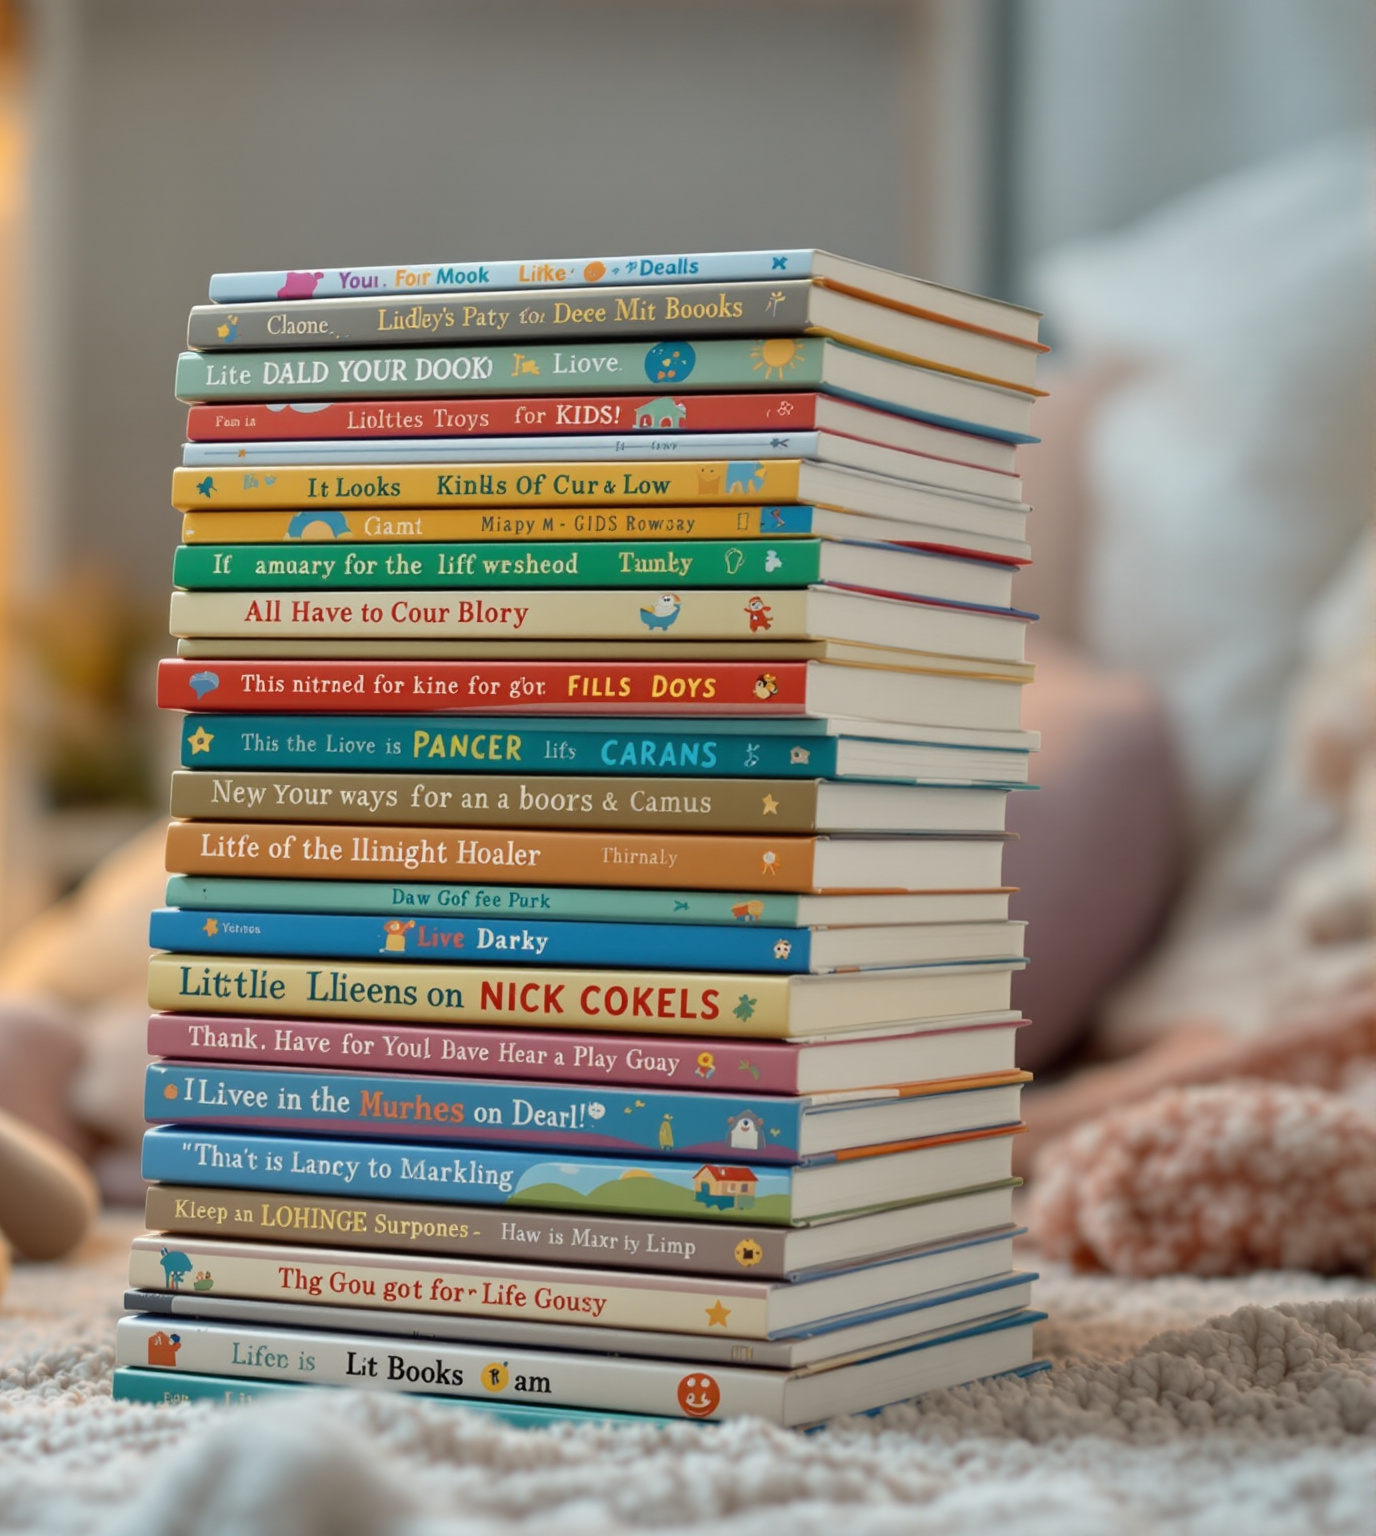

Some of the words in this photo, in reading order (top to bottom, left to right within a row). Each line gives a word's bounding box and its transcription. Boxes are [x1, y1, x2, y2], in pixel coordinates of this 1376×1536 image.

[436, 266, 490, 285] Mook
[639, 257, 699, 277] Dealls
[461, 306, 510, 330] Paty
[614, 297, 656, 322] Mit
[665, 293, 744, 320] Boooks
[206, 364, 252, 386] Lite
[262, 361, 330, 385] DALD
[338, 358, 408, 383] YOUR
[514, 406, 547, 424] for
[555, 404, 621, 425] KIDS!
[307, 477, 330, 498] It
[335, 475, 402, 498] Looks
[516, 473, 547, 495] Of
[552, 473, 600, 495] Cur
[603, 481, 617, 495] &
[623, 473, 672, 495] Low
[481, 515, 536, 535] Miapy
[542, 517, 555, 532] M
[574, 515, 618, 532] GIDS
[212, 553, 233, 574] If
[344, 552, 379, 575] for
[385, 553, 423, 575] the
[244, 600, 281, 623] All
[291, 601, 353, 623] Have
[361, 602, 384, 623] to
[390, 601, 450, 624] Cour
[457, 600, 529, 629] Blory
[240, 673, 285, 694] This
[373, 674, 405, 695] for
[411, 675, 459, 695] kine
[467, 675, 501, 696] for
[567, 674, 632, 698] FILLS
[650, 674, 718, 699] DOYS
[240, 732, 280, 753] This
[286, 733, 318, 753] the
[324, 734, 376, 754] Liove
[385, 736, 403, 755] is
[412, 730, 522, 761] PANCER
[600, 739, 718, 769] CARANS
[210, 779, 267, 809] New
[273, 783, 333, 806] Your
[339, 788, 399, 813] ways
[410, 784, 453, 809] for
[460, 793, 490, 809] an
[497, 795, 510, 811] a
[519, 784, 594, 813] boors
[601, 792, 620, 812] &
[629, 789, 713, 814] Camus
[268, 834, 298, 860] of
[302, 836, 344, 861] the
[455, 839, 542, 867] Hoaler
[392, 888, 431, 906] Daw
[437, 889, 470, 908] Gof
[475, 890, 502, 908] fee
[508, 891, 551, 909] Purk
[416, 925, 465, 949] Live
[476, 927, 550, 955] Darky
[426, 984, 466, 1009] on
[480, 981, 566, 1015] NICK
[580, 984, 721, 1021] COKELS
[188, 1024, 267, 1051] Thank.
[274, 1029, 331, 1054] Have
[341, 1032, 375, 1056] for
[498, 1042, 548, 1066] Hear
[553, 1052, 566, 1067] a
[573, 1046, 619, 1074] Play
[626, 1049, 681, 1078] Goay
[183, 1077, 195, 1101] I
[197, 1078, 269, 1109] Livee
[277, 1087, 303, 1112] in
[310, 1085, 351, 1114] the
[359, 1089, 466, 1124] Murhes
[473, 1104, 504, 1125] on
[511, 1099, 587, 1130] Dearl!
[264, 1151, 284, 1173] is
[367, 1157, 393, 1180] to
[400, 1157, 515, 1193] Markling
[233, 1208, 255, 1223] an
[260, 1203, 367, 1233] LOHINGE
[374, 1213, 469, 1240] Surpones
[500, 1222, 542, 1243] Haw
[548, 1227, 565, 1246] is
[645, 1233, 697, 1259] Limp
[278, 1266, 323, 1296] Thg
[328, 1270, 376, 1296] Gou
[382, 1280, 423, 1302] got
[481, 1282, 528, 1307] Life
[533, 1286, 608, 1318] Gousy
[297, 1350, 316, 1372] is
[346, 1351, 379, 1378] Lit
[386, 1354, 464, 1387] Books
[513, 1373, 552, 1393] am
